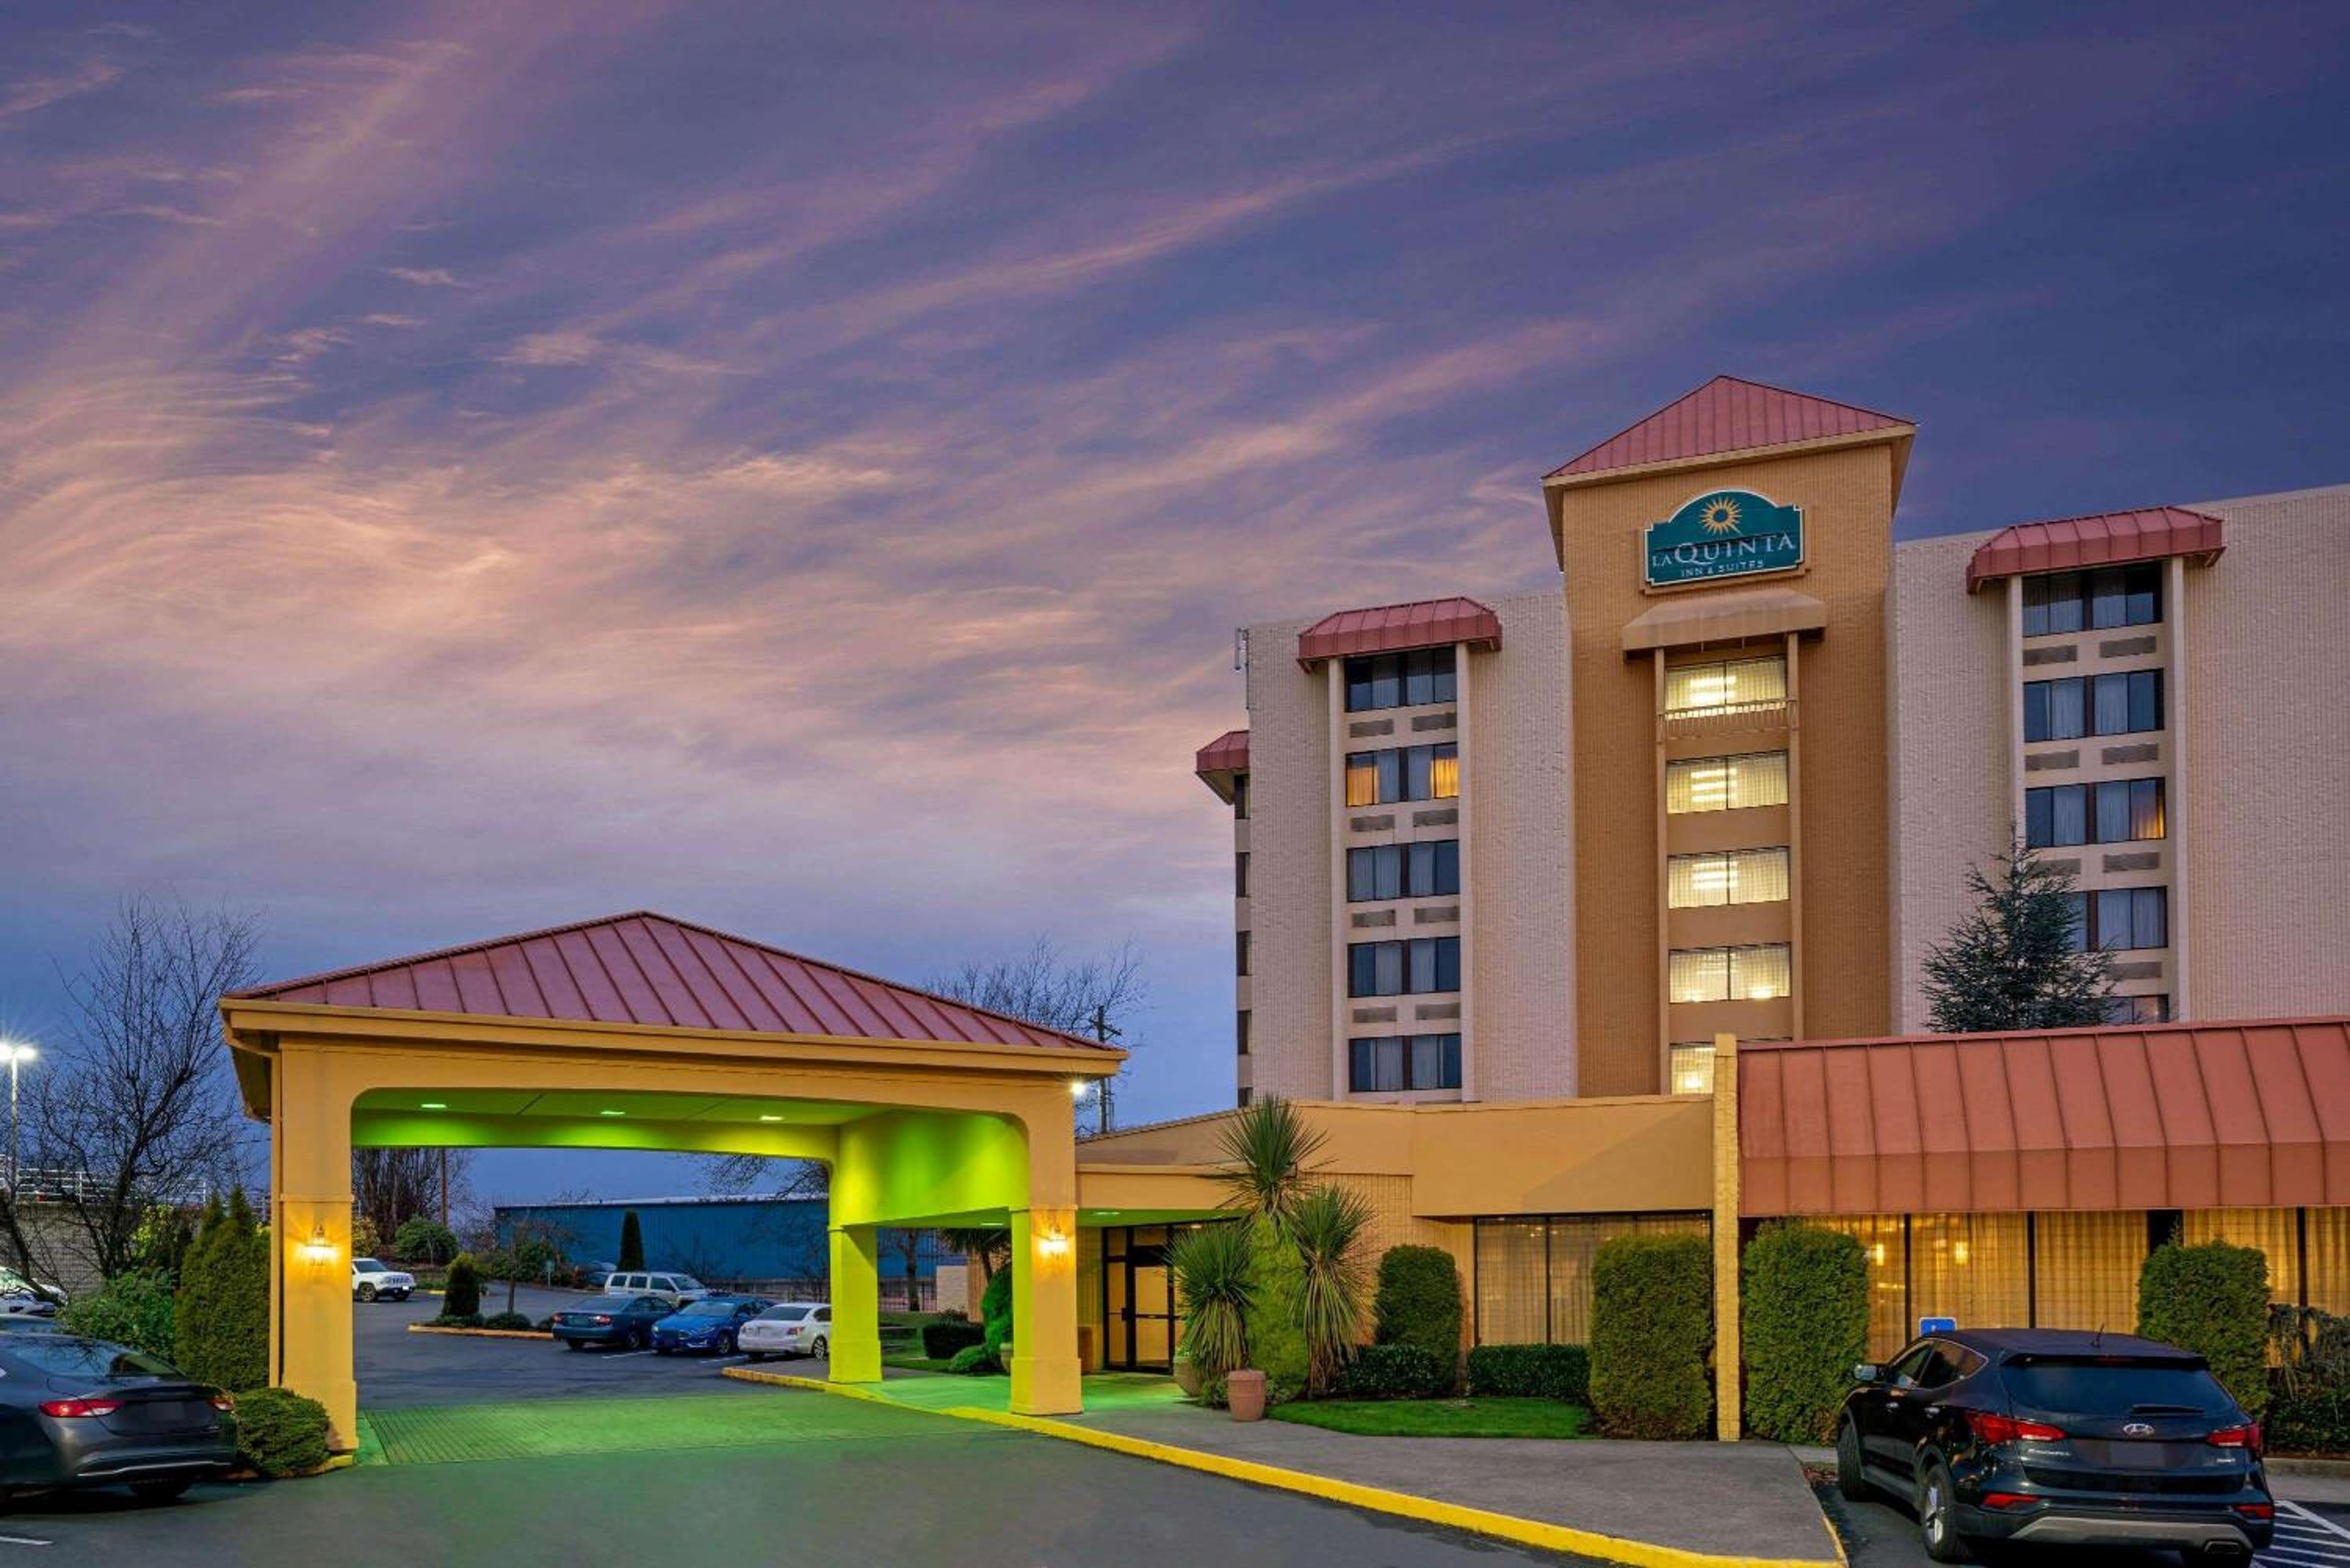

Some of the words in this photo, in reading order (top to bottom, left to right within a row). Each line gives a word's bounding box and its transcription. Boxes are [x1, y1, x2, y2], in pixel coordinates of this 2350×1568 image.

[1652, 554, 1672, 568] LA
[1674, 533, 1795, 565] QUINTA
[1680, 567, 1705, 578] INN
[1718, 559, 1764, 573] SUITES
